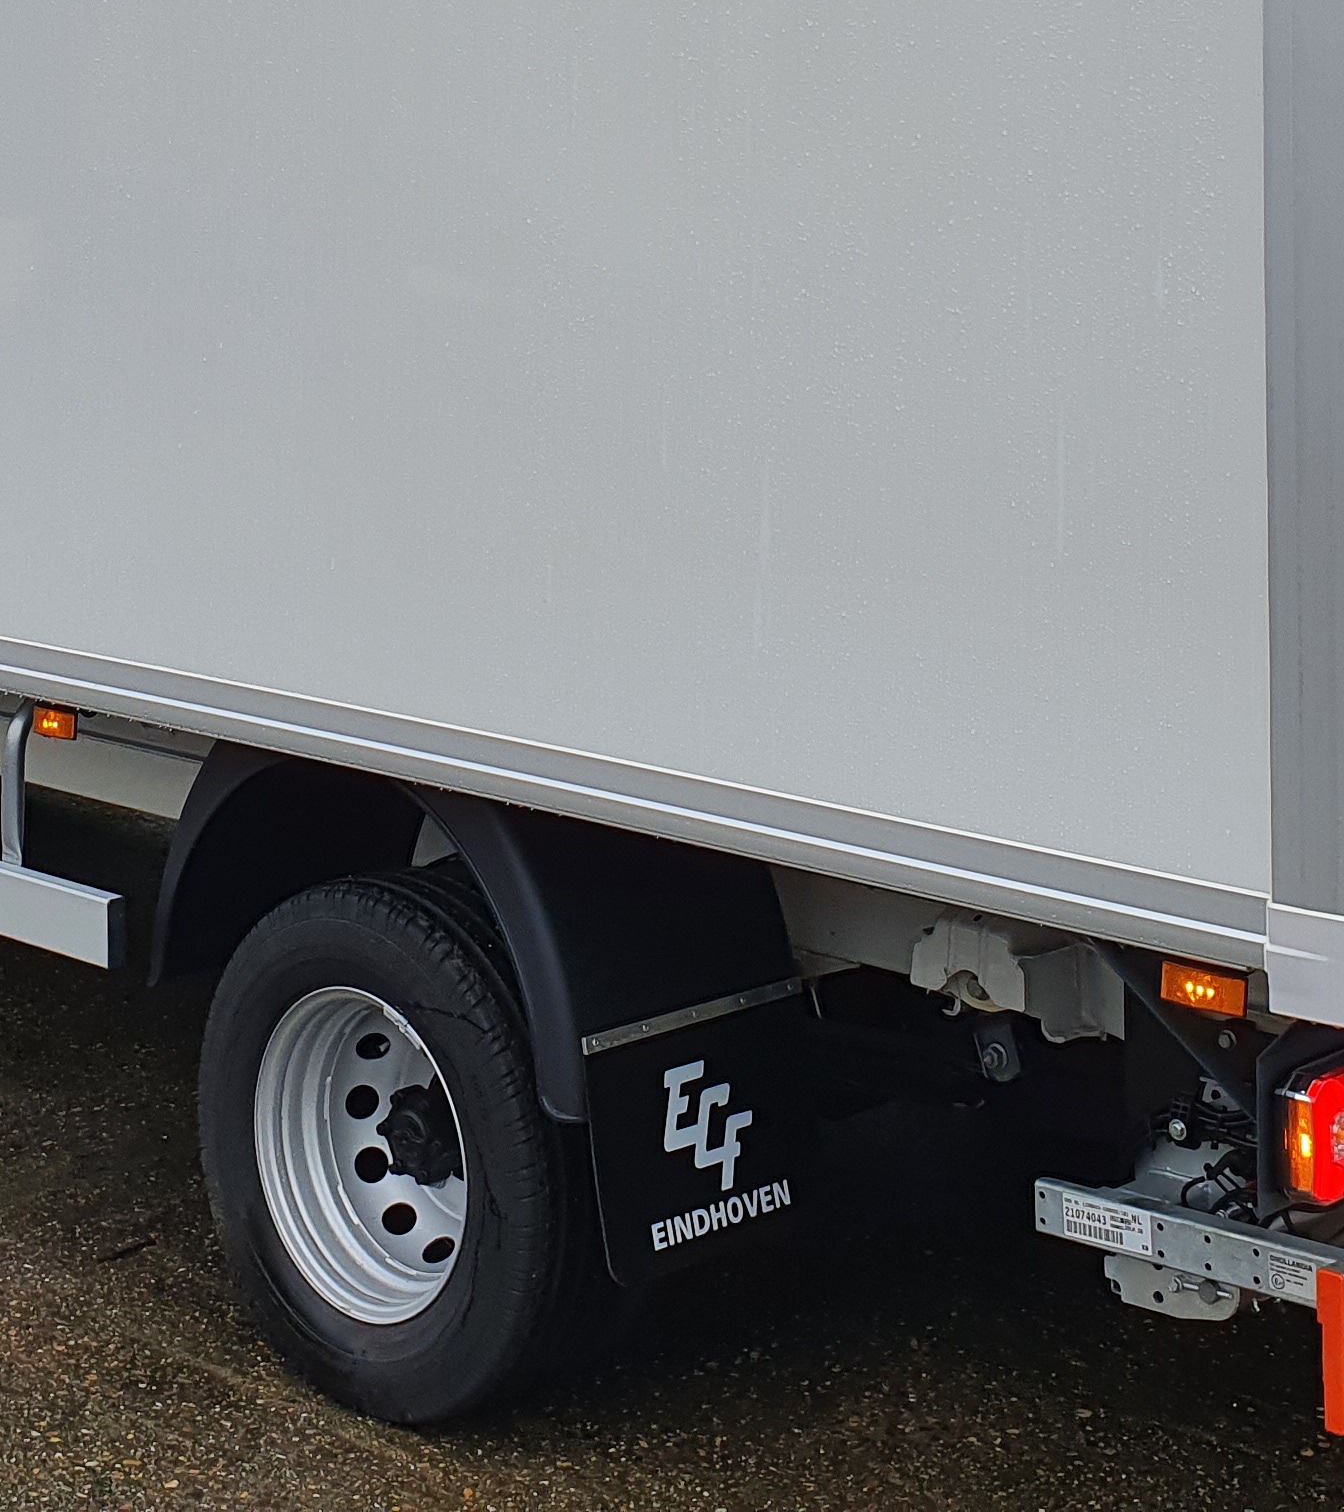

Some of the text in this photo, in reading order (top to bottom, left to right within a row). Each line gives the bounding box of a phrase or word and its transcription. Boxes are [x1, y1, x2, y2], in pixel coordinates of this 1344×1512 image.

[664, 1060, 753, 1191] ECF
[651, 1179, 791, 1251] EINDHOVEN
[1065, 1206, 1107, 1226] 21074043
